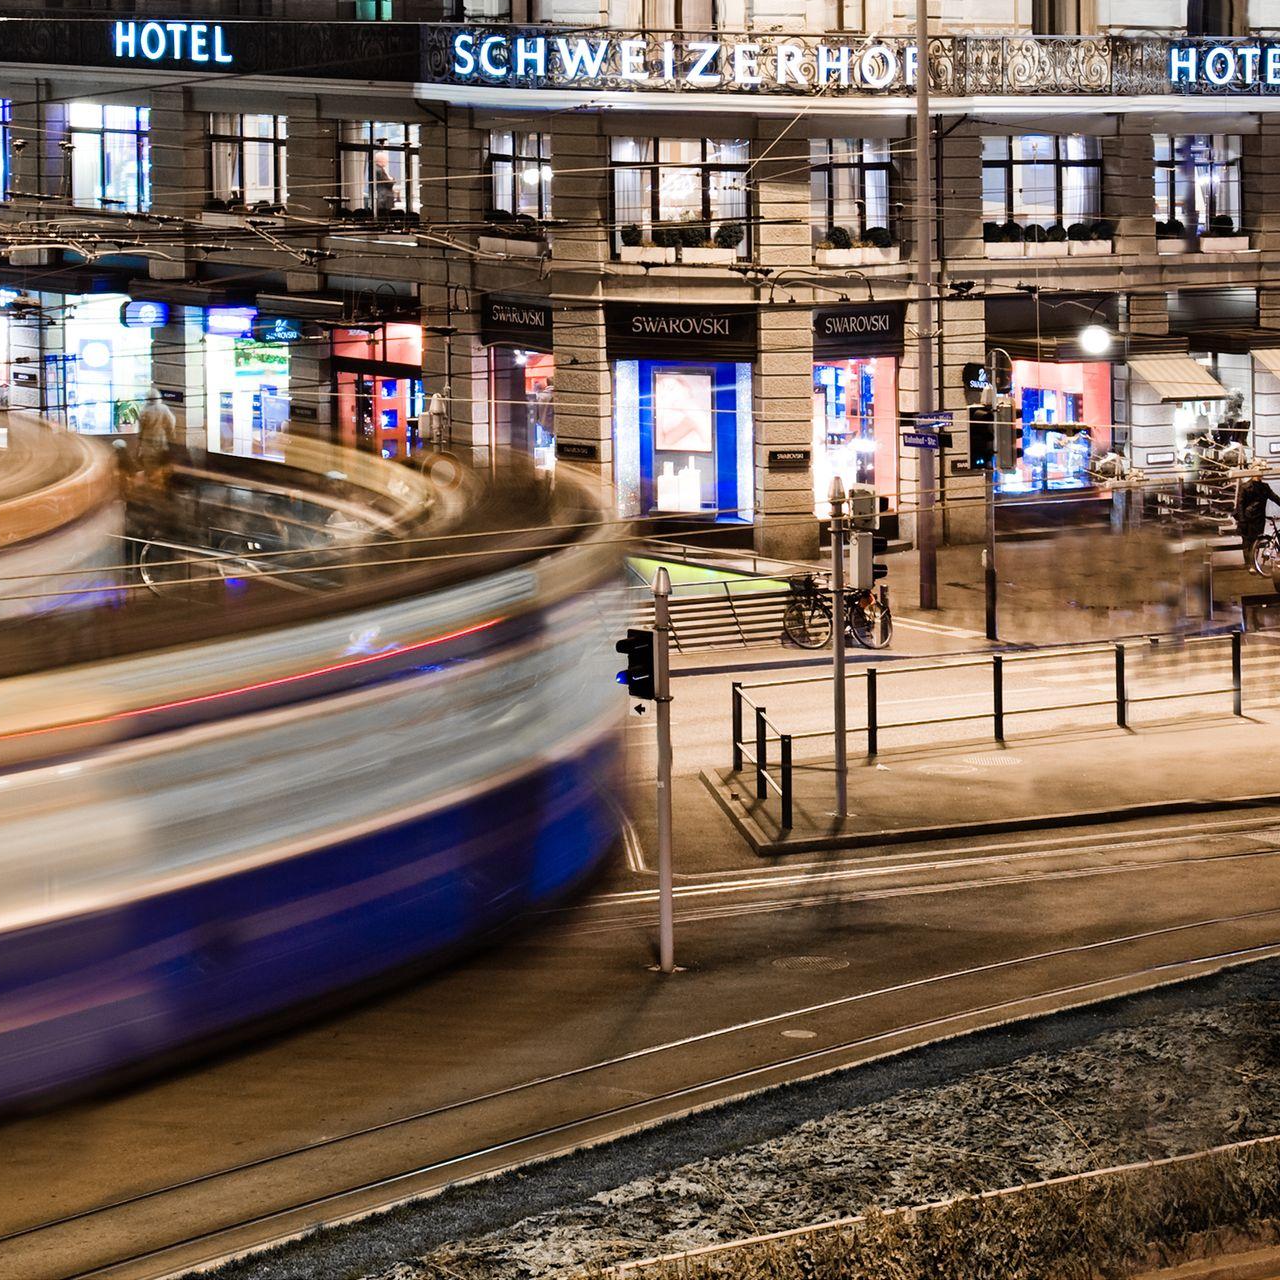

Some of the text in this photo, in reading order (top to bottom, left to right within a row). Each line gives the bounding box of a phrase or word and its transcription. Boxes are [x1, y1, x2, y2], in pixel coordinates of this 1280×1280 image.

[115, 21, 233, 63] HOTEL
[492, 304, 545, 327] SWAROVSKI
[631, 317, 730, 335] SWAROVSKI
[825, 314, 890, 335] SWAROVSKI
